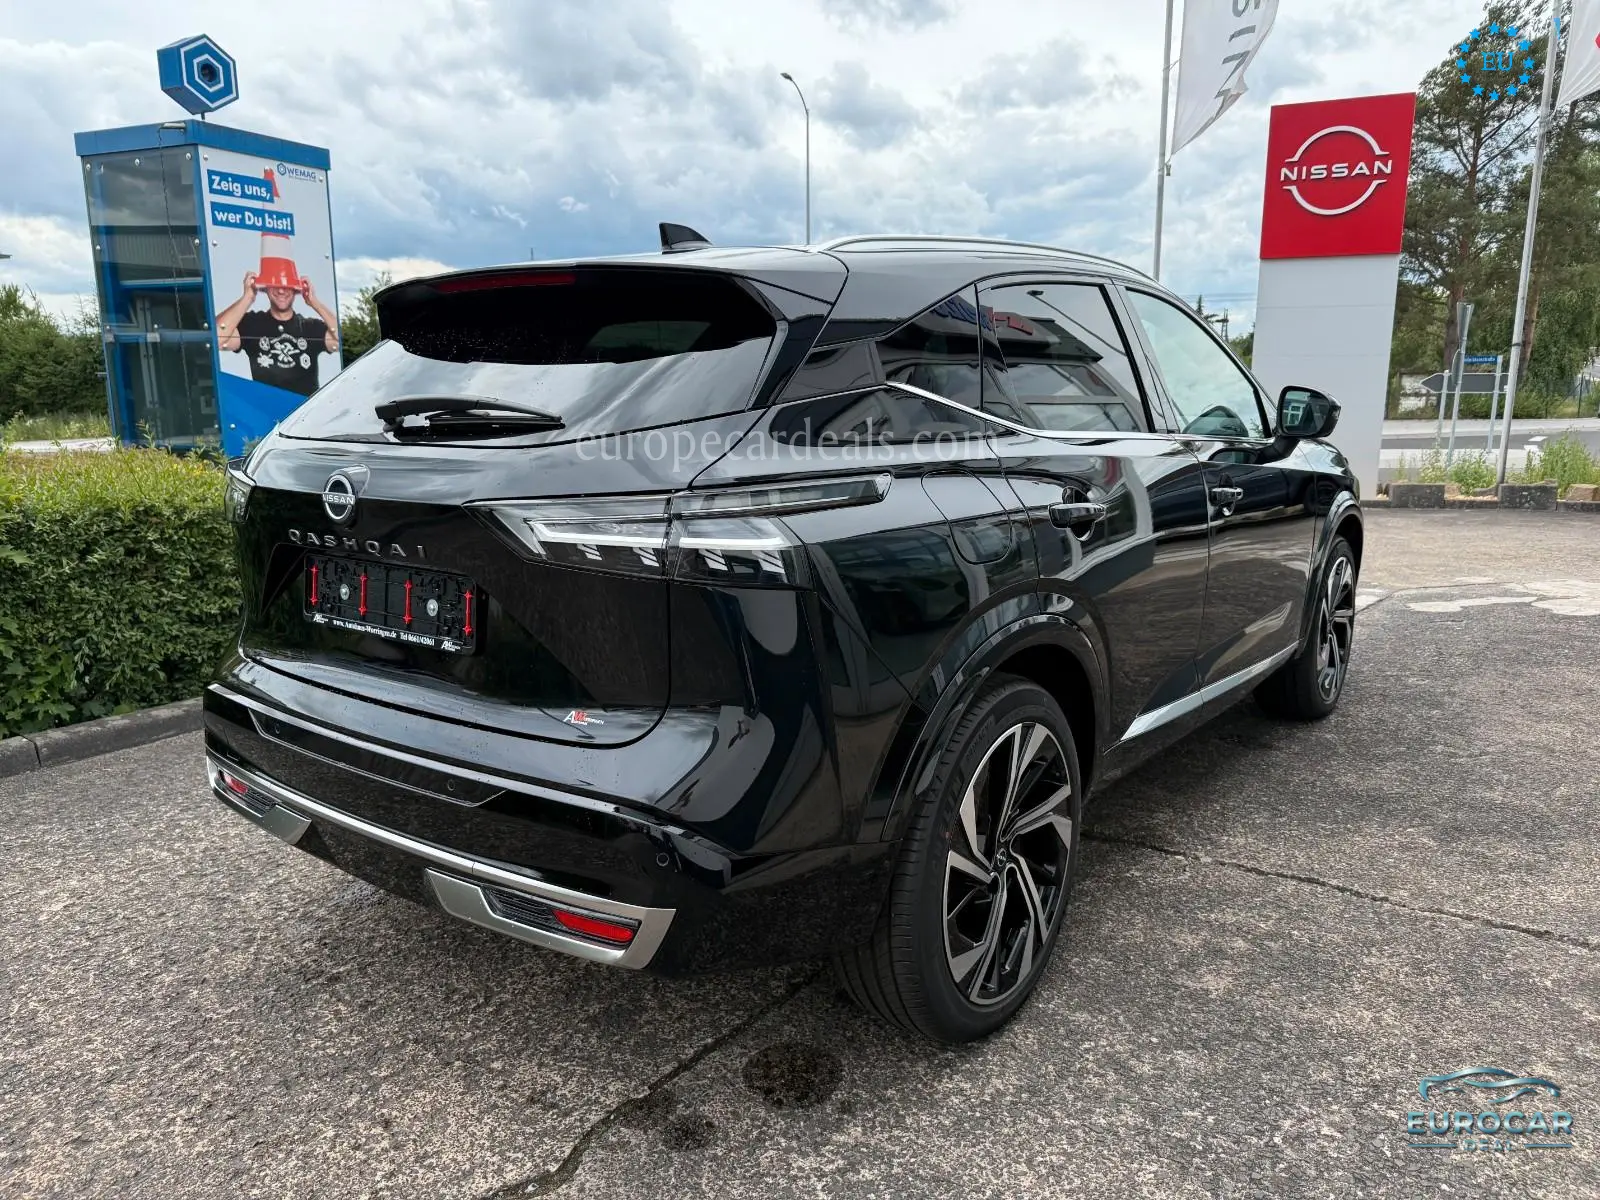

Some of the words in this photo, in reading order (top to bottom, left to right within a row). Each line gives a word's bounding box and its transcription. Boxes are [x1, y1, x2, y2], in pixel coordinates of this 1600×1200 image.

[287, 166, 317, 180] WEMAG
[1280, 160, 1393, 182] NISSAN
[211, 175, 242, 197] Zeig
[244, 184, 271, 200] uns,
[214, 210, 242, 224] wer
[244, 211, 263, 227] Du
[264, 213, 292, 231] bist!
[322, 493, 354, 505] NISSAN
[288, 528, 427, 559] QASHQAI
